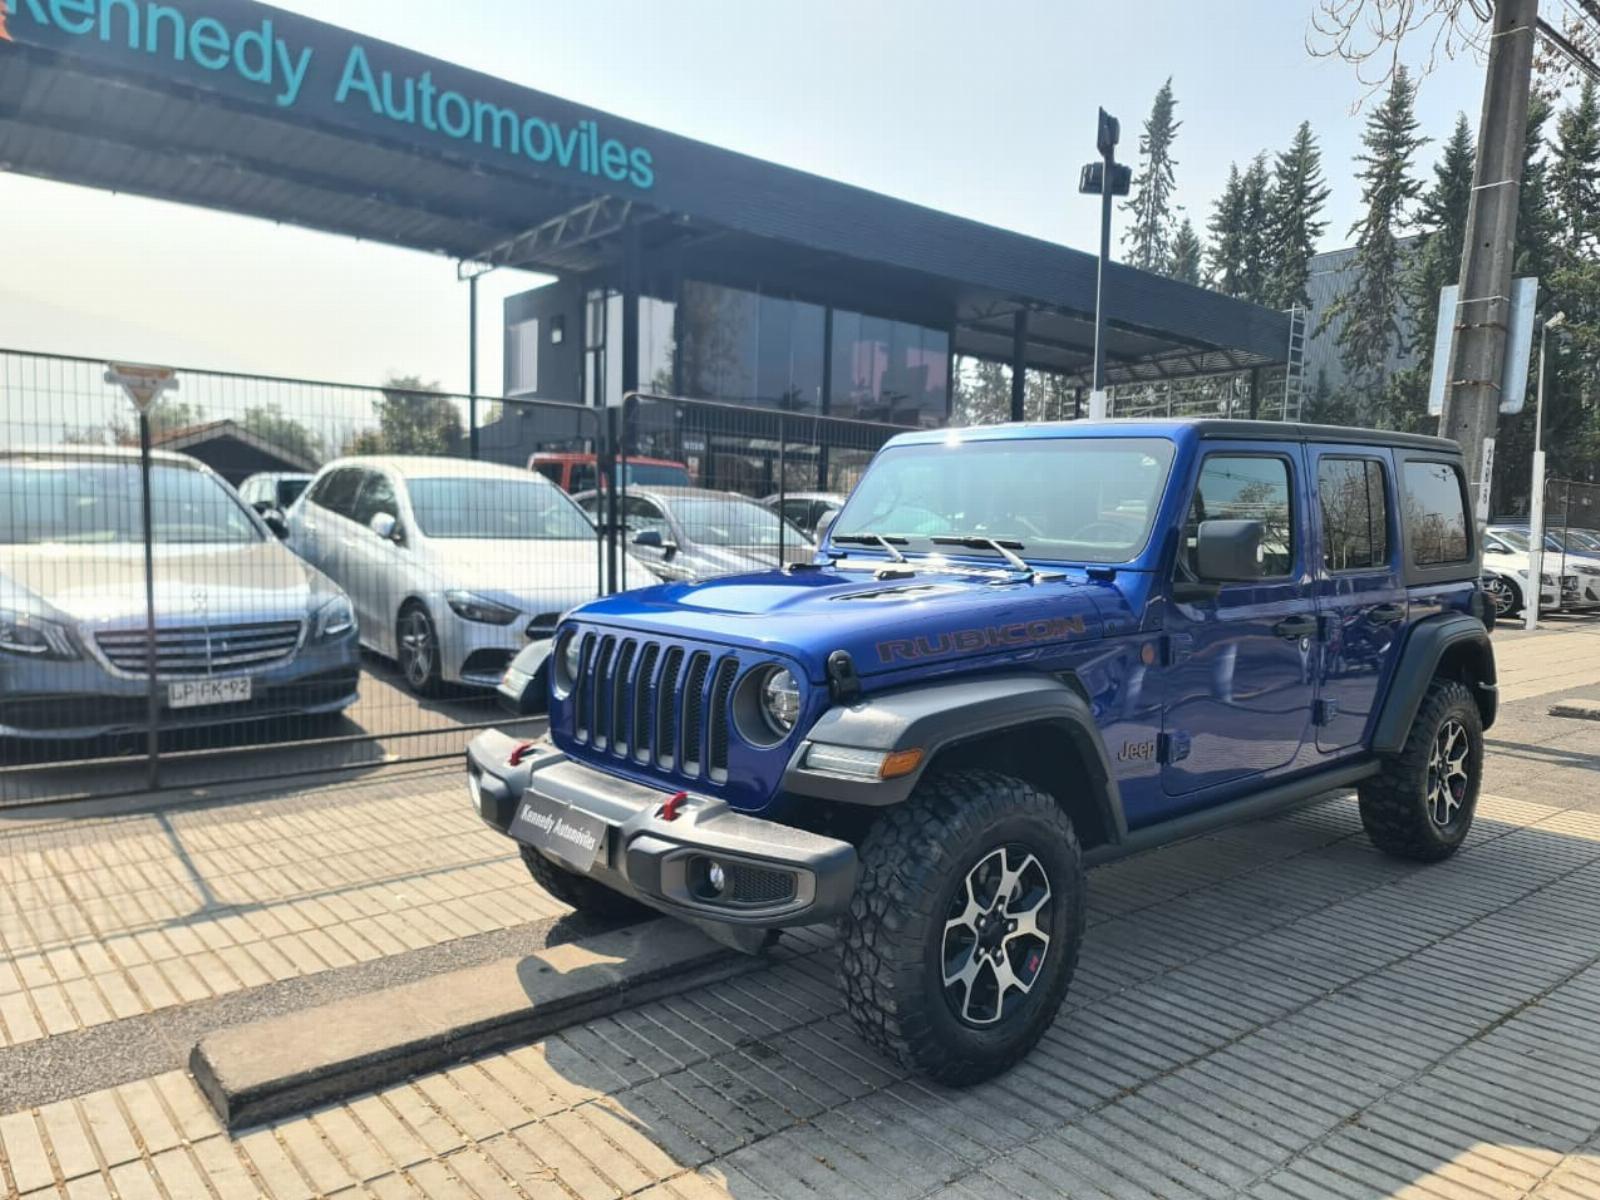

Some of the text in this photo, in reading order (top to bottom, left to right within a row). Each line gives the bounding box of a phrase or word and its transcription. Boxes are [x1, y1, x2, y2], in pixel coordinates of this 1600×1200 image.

[335, 45, 654, 190] Automoviles
[876, 614, 1087, 664] RUBICON
[1117, 741, 1155, 761] Jeep
[521, 804, 556, 835] Kennedy
